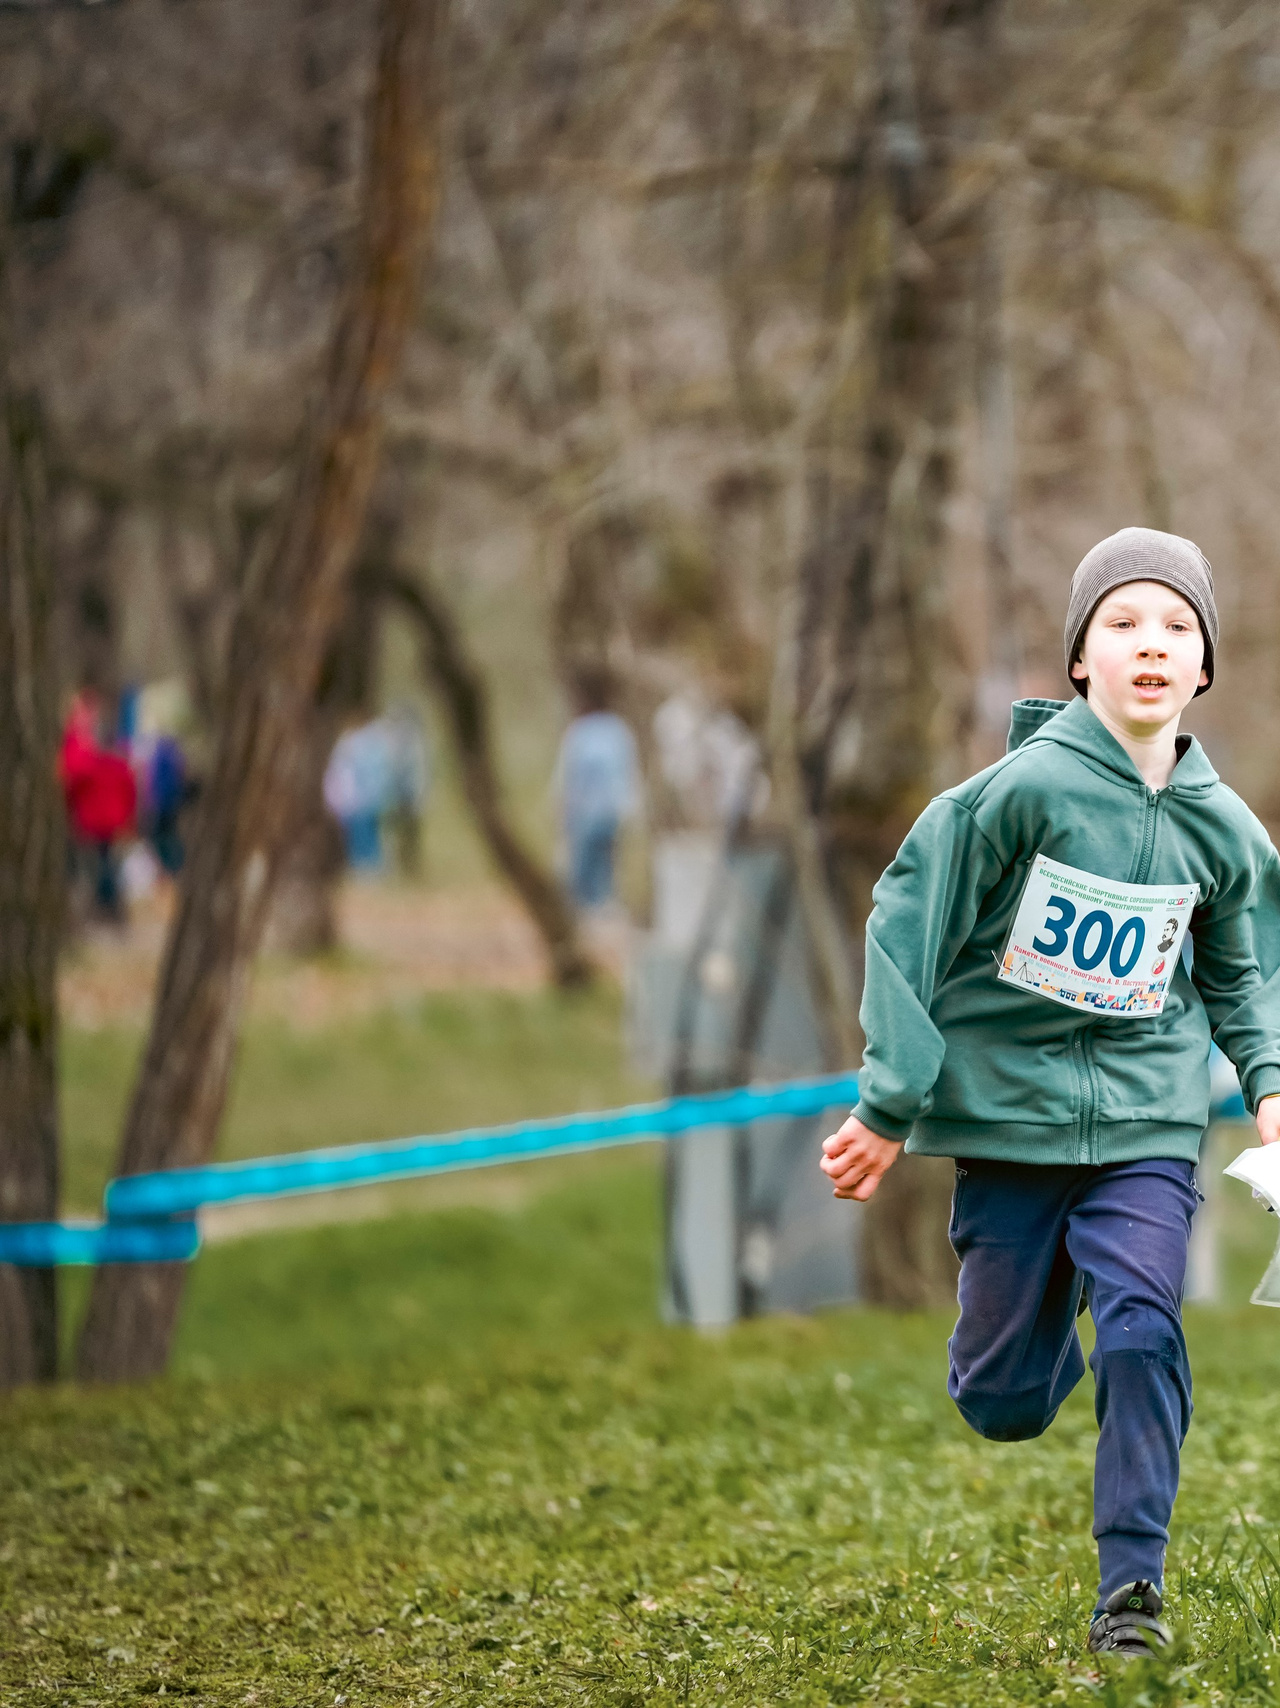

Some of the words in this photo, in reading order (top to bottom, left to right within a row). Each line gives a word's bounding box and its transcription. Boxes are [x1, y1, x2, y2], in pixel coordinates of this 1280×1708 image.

[1039, 868, 1088, 892] ВСЕРОССИЙСКИЕ
[1089, 886, 1129, 902] СПОРТИВНЫЕ
[1129, 896, 1167, 904] СОРЕВНОВАНИЯ
[1050, 881, 1059, 890] ПО
[1059, 885, 1103, 904] СПОРТИВНОМУ
[1103, 900, 1154, 912] ОРИЕНТИРОВАНИЮ
[1032, 895, 1146, 978] 300
[1013, 945, 1039, 960] Памяти
[1039, 957, 1069, 972] военного
[1070, 969, 1106, 983] топографа
